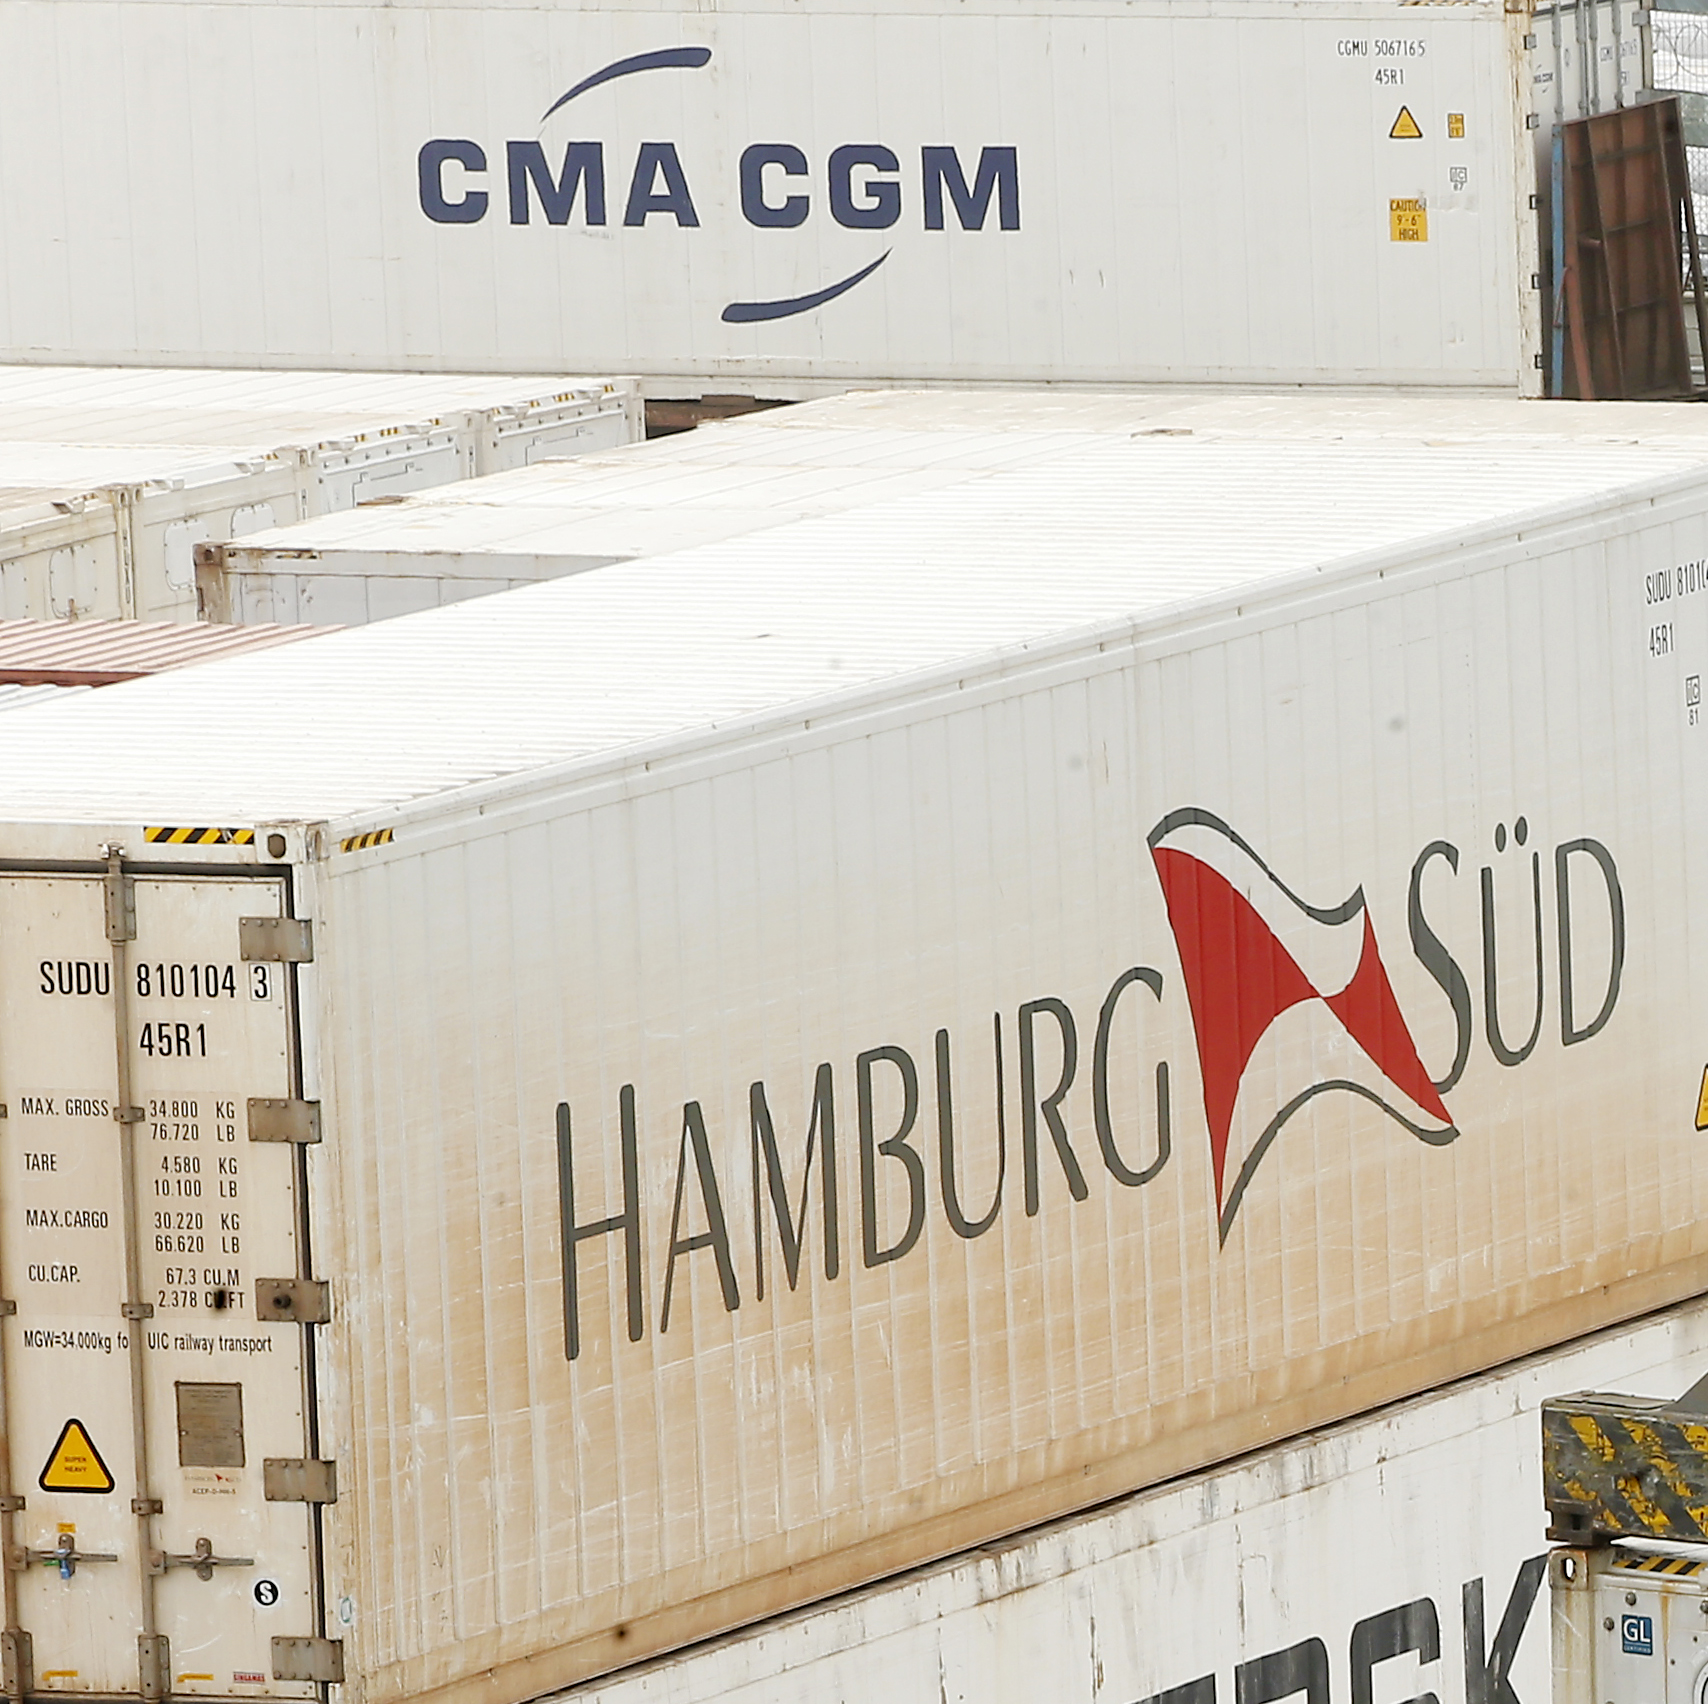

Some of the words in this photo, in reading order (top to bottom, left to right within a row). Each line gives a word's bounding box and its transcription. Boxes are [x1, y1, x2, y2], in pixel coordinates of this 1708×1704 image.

[1338, 40, 1368, 57] CGMU
[1375, 68, 1404, 85] 45R1
[419, 138, 701, 228] CMA
[739, 143, 1021, 232] CGM
[1398, 228, 1419, 241] HIGH
[1646, 569, 1672, 605] SUDU
[1649, 622, 1673, 657] 45R1
[40, 961, 110, 995] SUDU
[137, 963, 236, 998] 810104
[254, 965, 268, 999] 3
[140, 1022, 206, 1057] 45R1
[556, 966, 1172, 1360] HAMBURG
[1406, 816, 1625, 1093] SÜD
[21, 1098, 59, 1116] MAX.
[65, 1098, 109, 1117] GROSS
[150, 1100, 198, 1118] 34.800
[216, 1101, 235, 1119] KG
[150, 1123, 199, 1141] 76.720
[217, 1124, 235, 1142] LB
[24, 1153, 57, 1172] TARE
[161, 1156, 200, 1174] 4.580
[218, 1157, 237, 1175] KG
[154, 1179, 202, 1197] 10.100
[219, 1180, 237, 1198] LB
[26, 1209, 108, 1229] MAX.CARGO
[154, 1212, 203, 1230] 30.220
[221, 1213, 240, 1231] KG
[155, 1235, 204, 1253] 66.620
[222, 1236, 240, 1254] LB
[28, 1264, 80, 1283] CU.CAP.
[166, 1267, 196, 1286] 67.3
[203, 1268, 239, 1287] CU.M
[158, 1290, 197, 1309] 2.378
[117, 1331, 129, 1349] fo
[148, 1332, 169, 1350] UIC
[174, 1333, 214, 1355] railway
[219, 1334, 272, 1356] transport
[1623, 1618, 1651, 1643] GL
